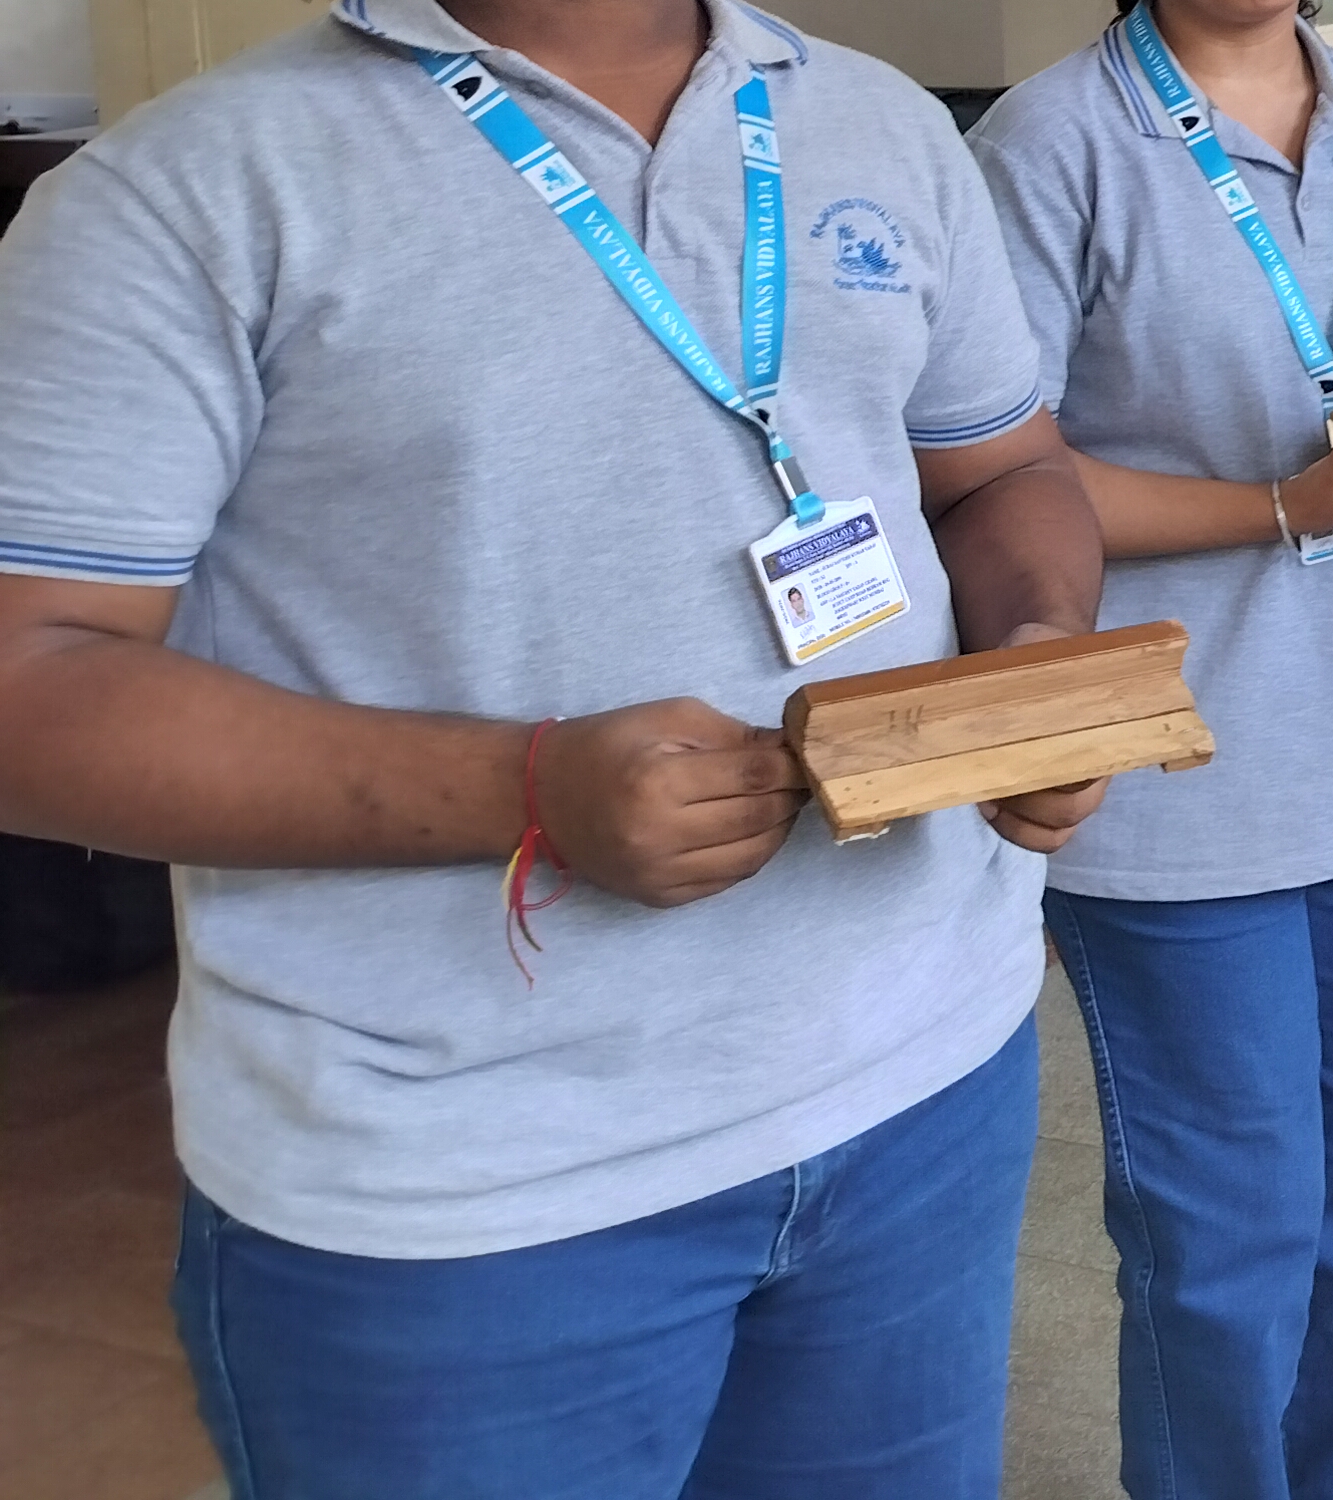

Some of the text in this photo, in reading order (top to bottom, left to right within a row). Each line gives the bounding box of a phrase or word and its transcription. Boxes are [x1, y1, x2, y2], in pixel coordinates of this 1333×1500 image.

[1143, 42, 1182, 99] RAJHANS
[583, 209, 727, 392] RAJHANS VIDYALAYA
[753, 180, 776, 377] RAJHANS VIDYALAYA
[1248, 221, 1325, 361] RAJHANS VIDYALAYA
